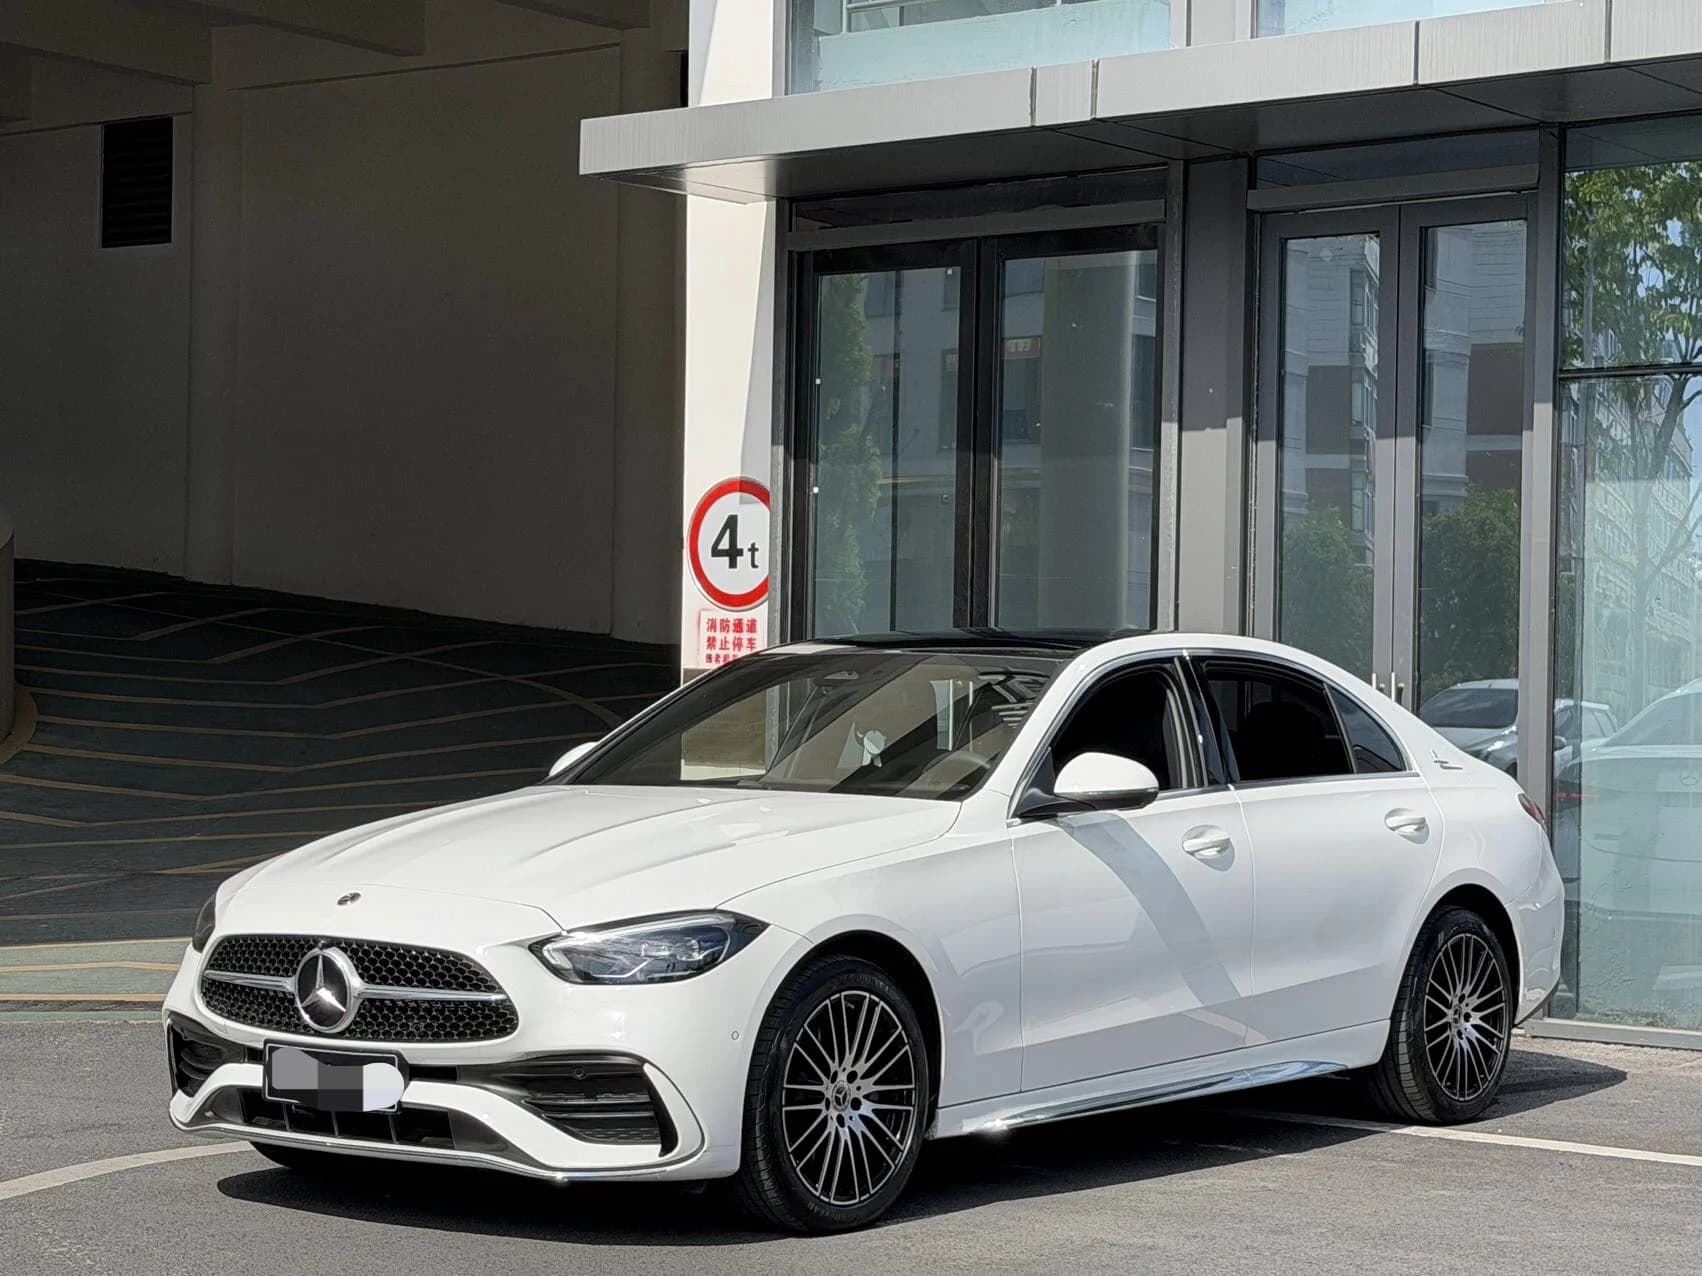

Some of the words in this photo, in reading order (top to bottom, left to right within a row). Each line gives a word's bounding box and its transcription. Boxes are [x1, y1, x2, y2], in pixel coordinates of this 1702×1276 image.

[706, 618, 758, 634] 消防通道
[706, 635, 758, 652] 禁止停车
